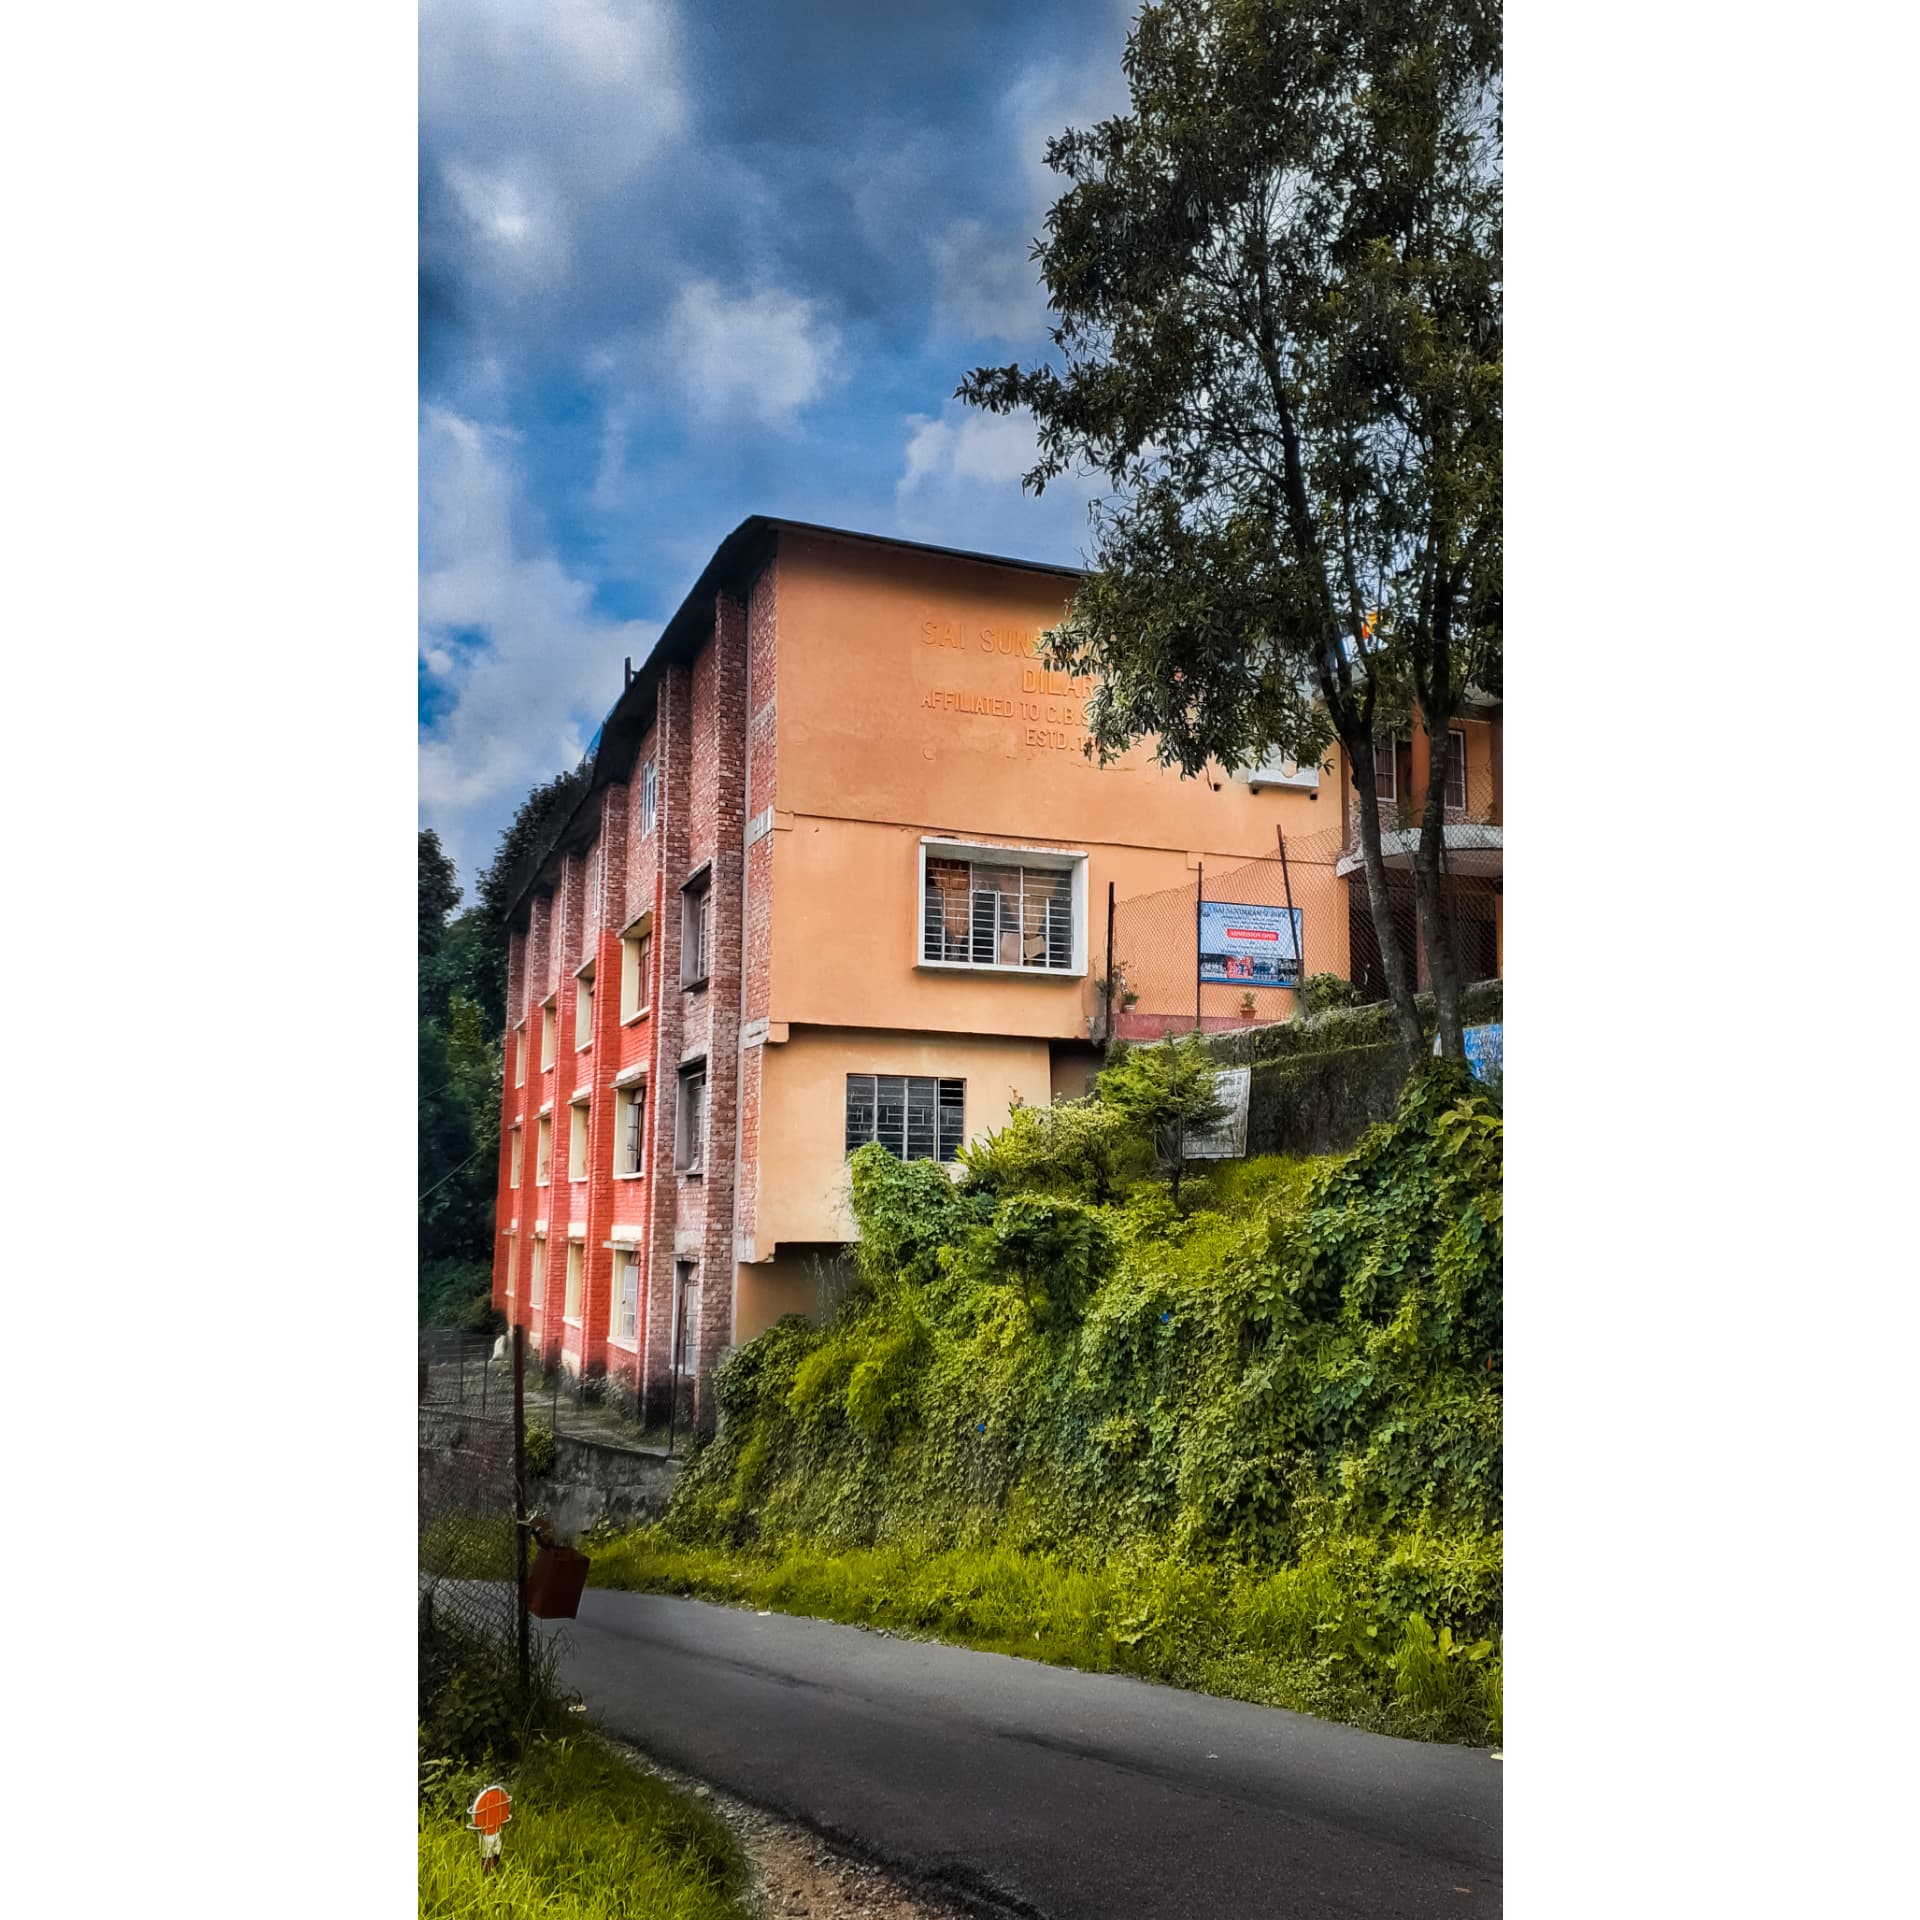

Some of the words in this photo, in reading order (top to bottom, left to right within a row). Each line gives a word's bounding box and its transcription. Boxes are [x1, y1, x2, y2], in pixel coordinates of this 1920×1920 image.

[921, 621, 966, 650] SAI
[979, 628, 1044, 660] SUN
[1023, 669, 1094, 699] DILAR
[921, 689, 1014, 718] AFFILIATED
[1019, 702, 1039, 721] TO
